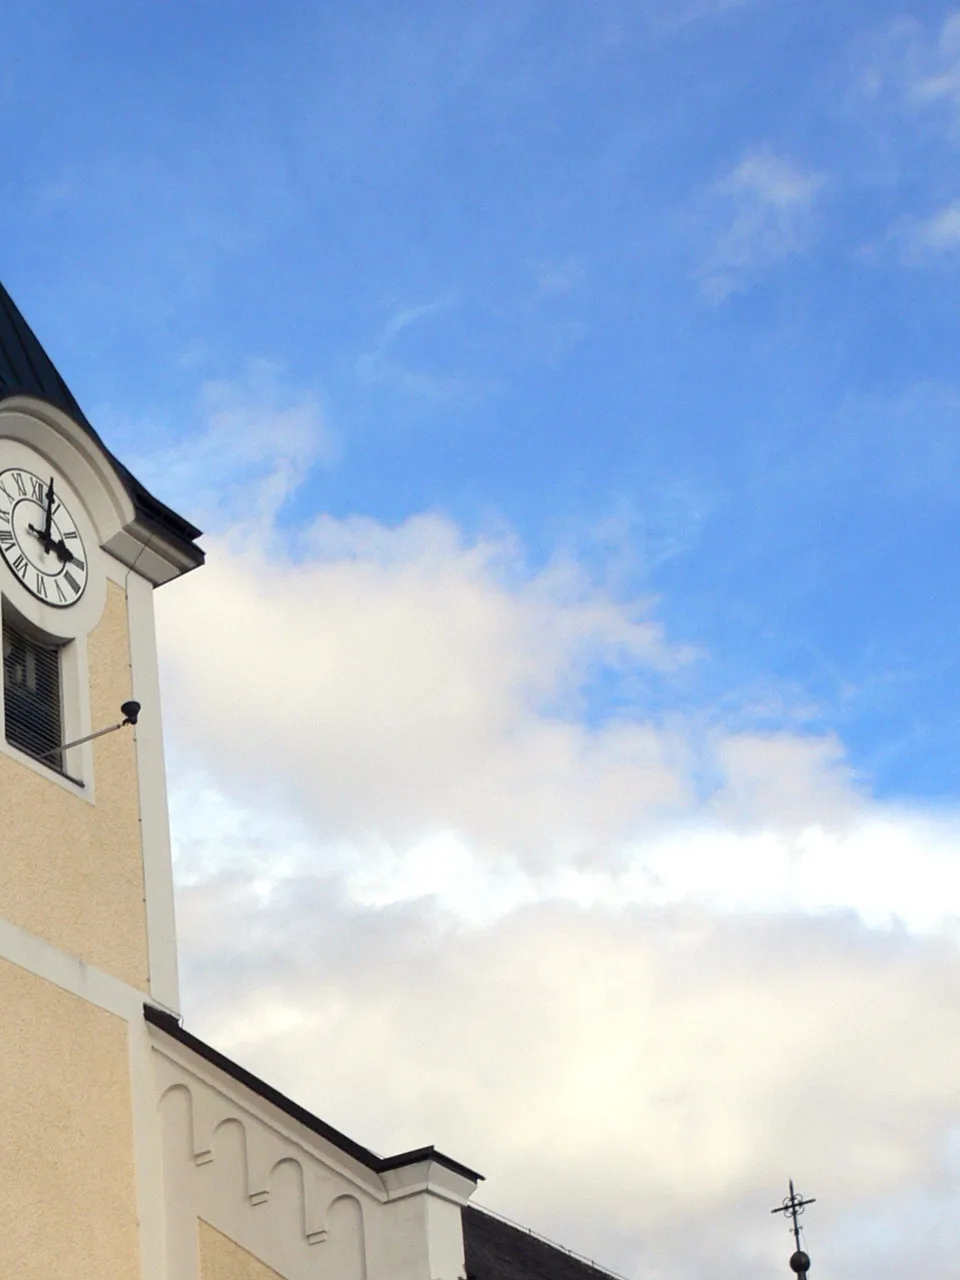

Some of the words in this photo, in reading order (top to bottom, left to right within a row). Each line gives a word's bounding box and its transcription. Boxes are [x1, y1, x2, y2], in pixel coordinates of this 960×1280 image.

[12, 473, 27, 496] XI
[30, 477, 43, 504] XII
[52, 504, 60, 515] I
[64, 531, 77, 539] II
[13, 555, 28, 579] VII
[37, 574, 48, 598] VI
[55, 579, 67, 602] V
